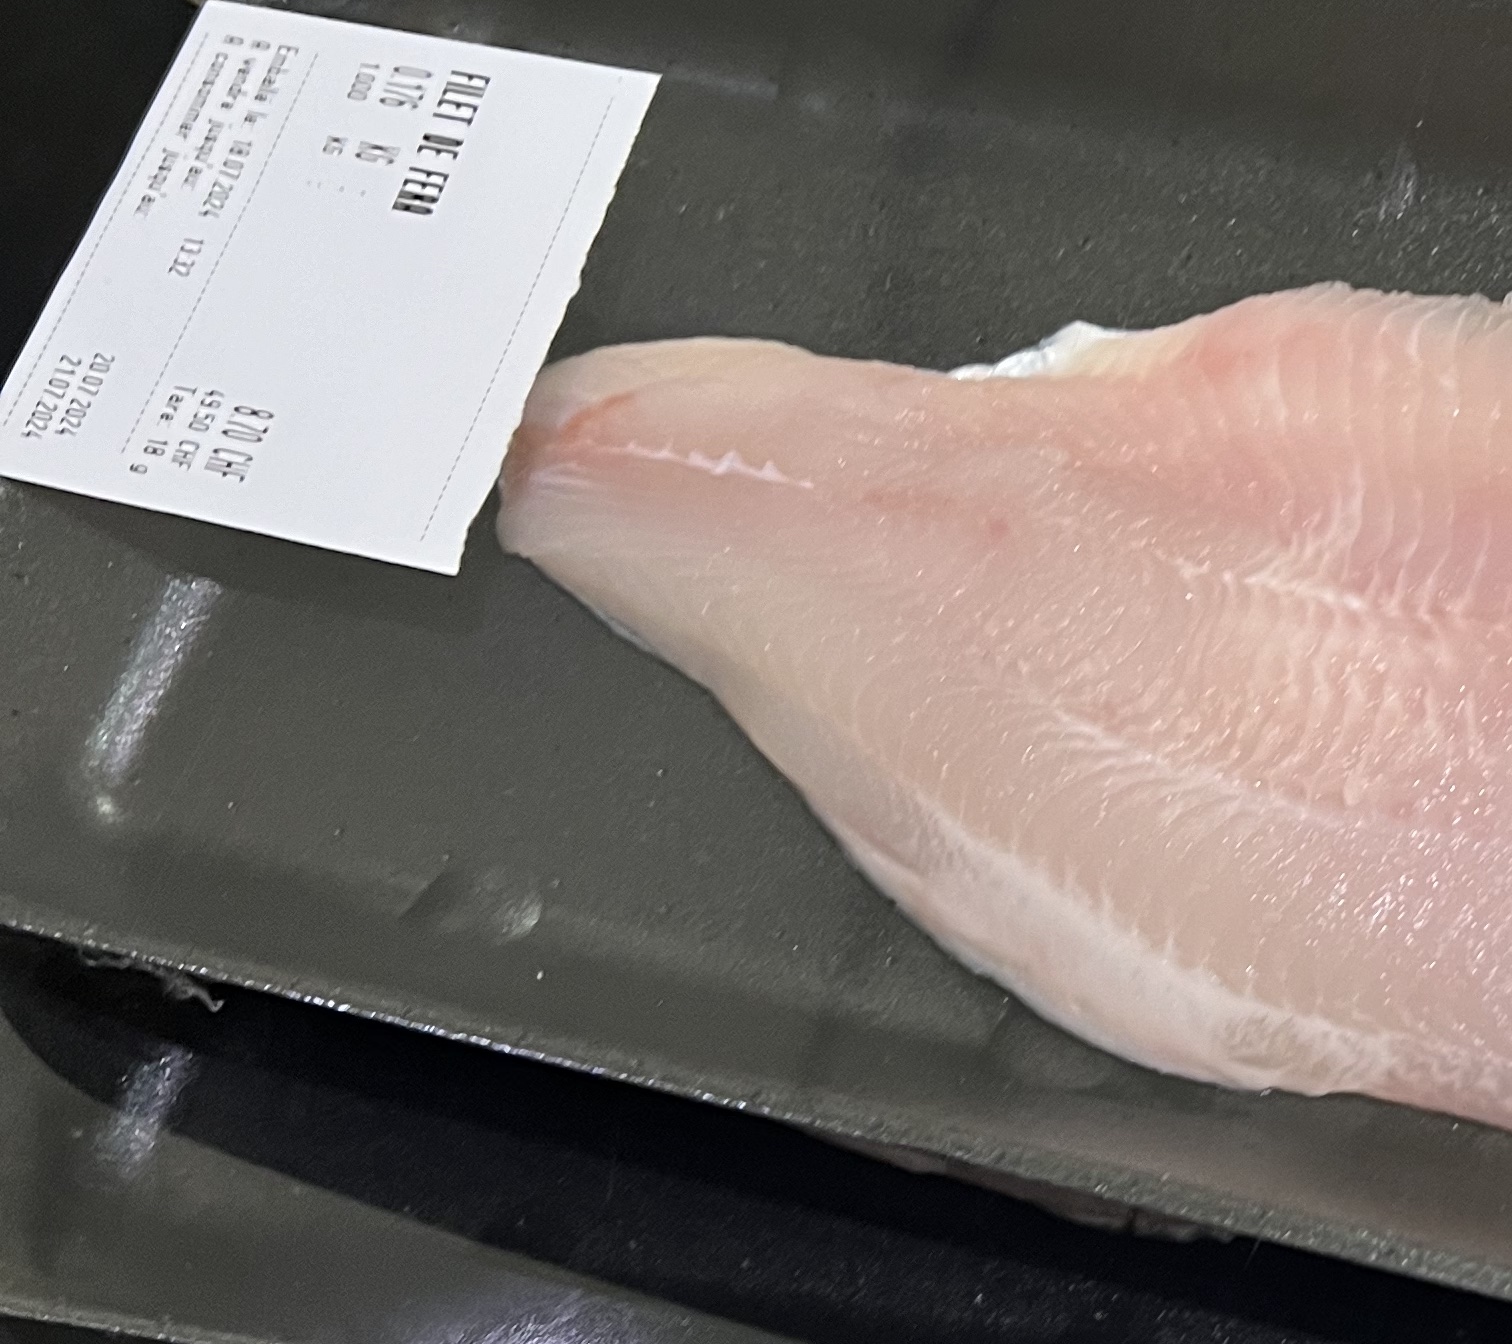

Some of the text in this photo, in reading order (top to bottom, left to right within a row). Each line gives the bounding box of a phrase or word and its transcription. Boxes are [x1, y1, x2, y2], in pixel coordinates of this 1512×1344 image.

[377, 64, 434, 111] 0.176
[391, 70, 491, 216] FILET DE FERA
[141, 437, 169, 457] 18
[168, 388, 225, 470] 49.50 CHF
[201, 404, 275, 482] 8.70 CHF
[127, 462, 149, 475] g
